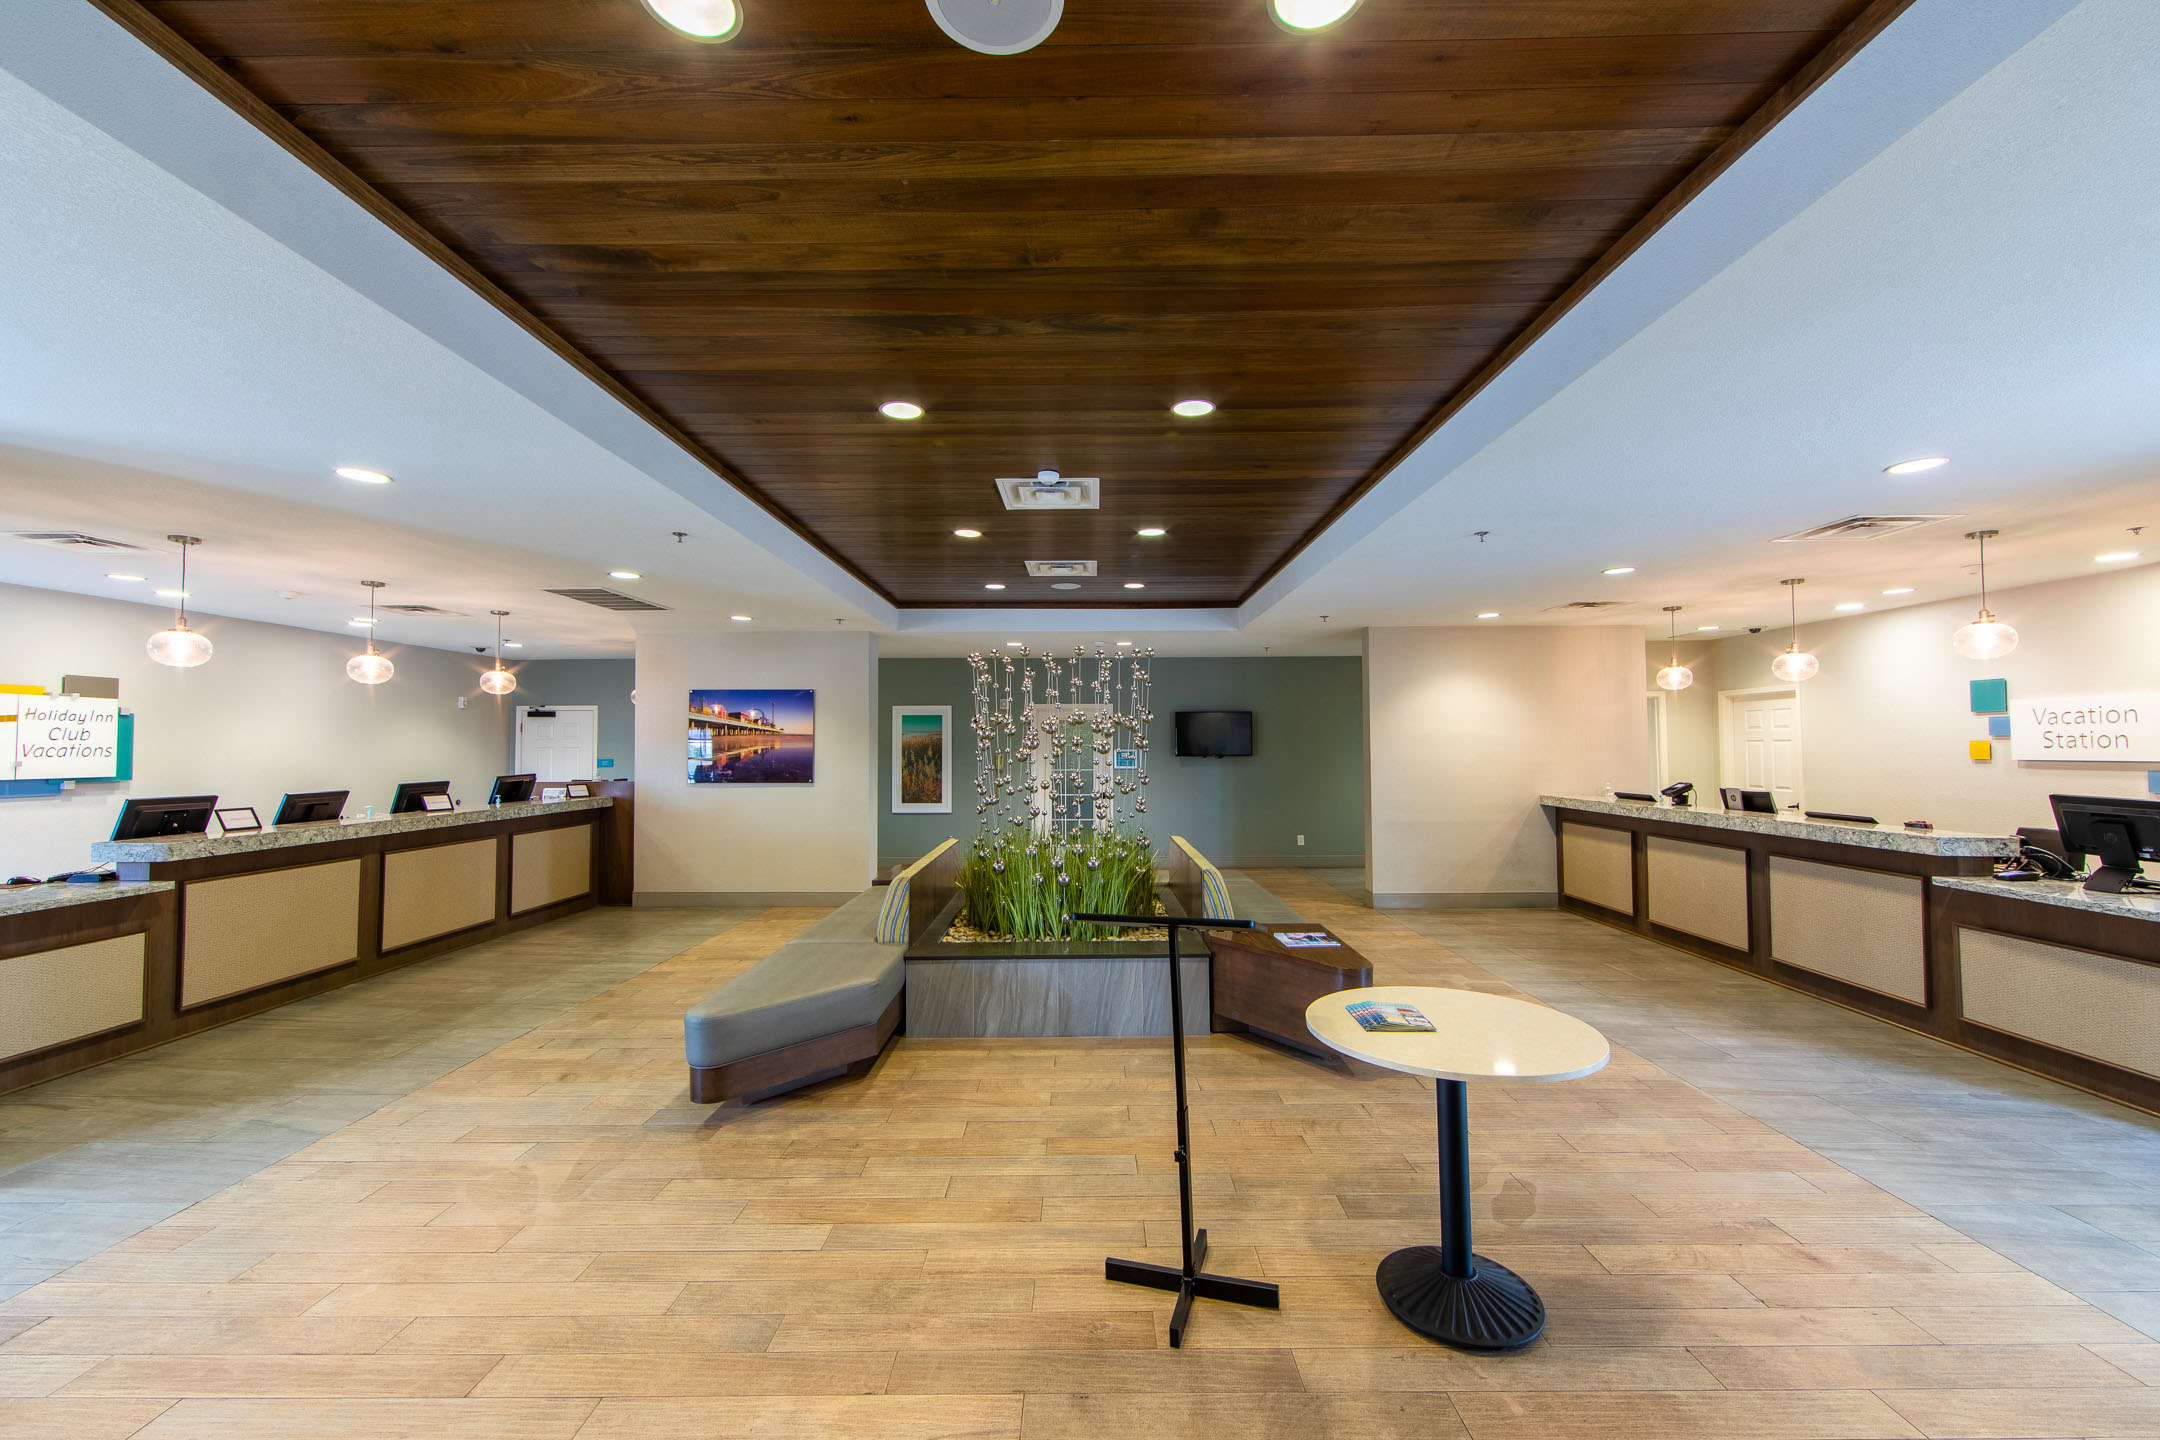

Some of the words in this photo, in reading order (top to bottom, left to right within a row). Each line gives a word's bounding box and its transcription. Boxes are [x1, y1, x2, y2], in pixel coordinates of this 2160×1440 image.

[25, 707, 87, 725] Holiday
[89, 710, 114, 723] Inn
[2032, 706, 2138, 725] Vacation
[49, 727, 91, 741] Club
[2042, 730, 2129, 749] Station
[22, 743, 113, 758] Vacations
